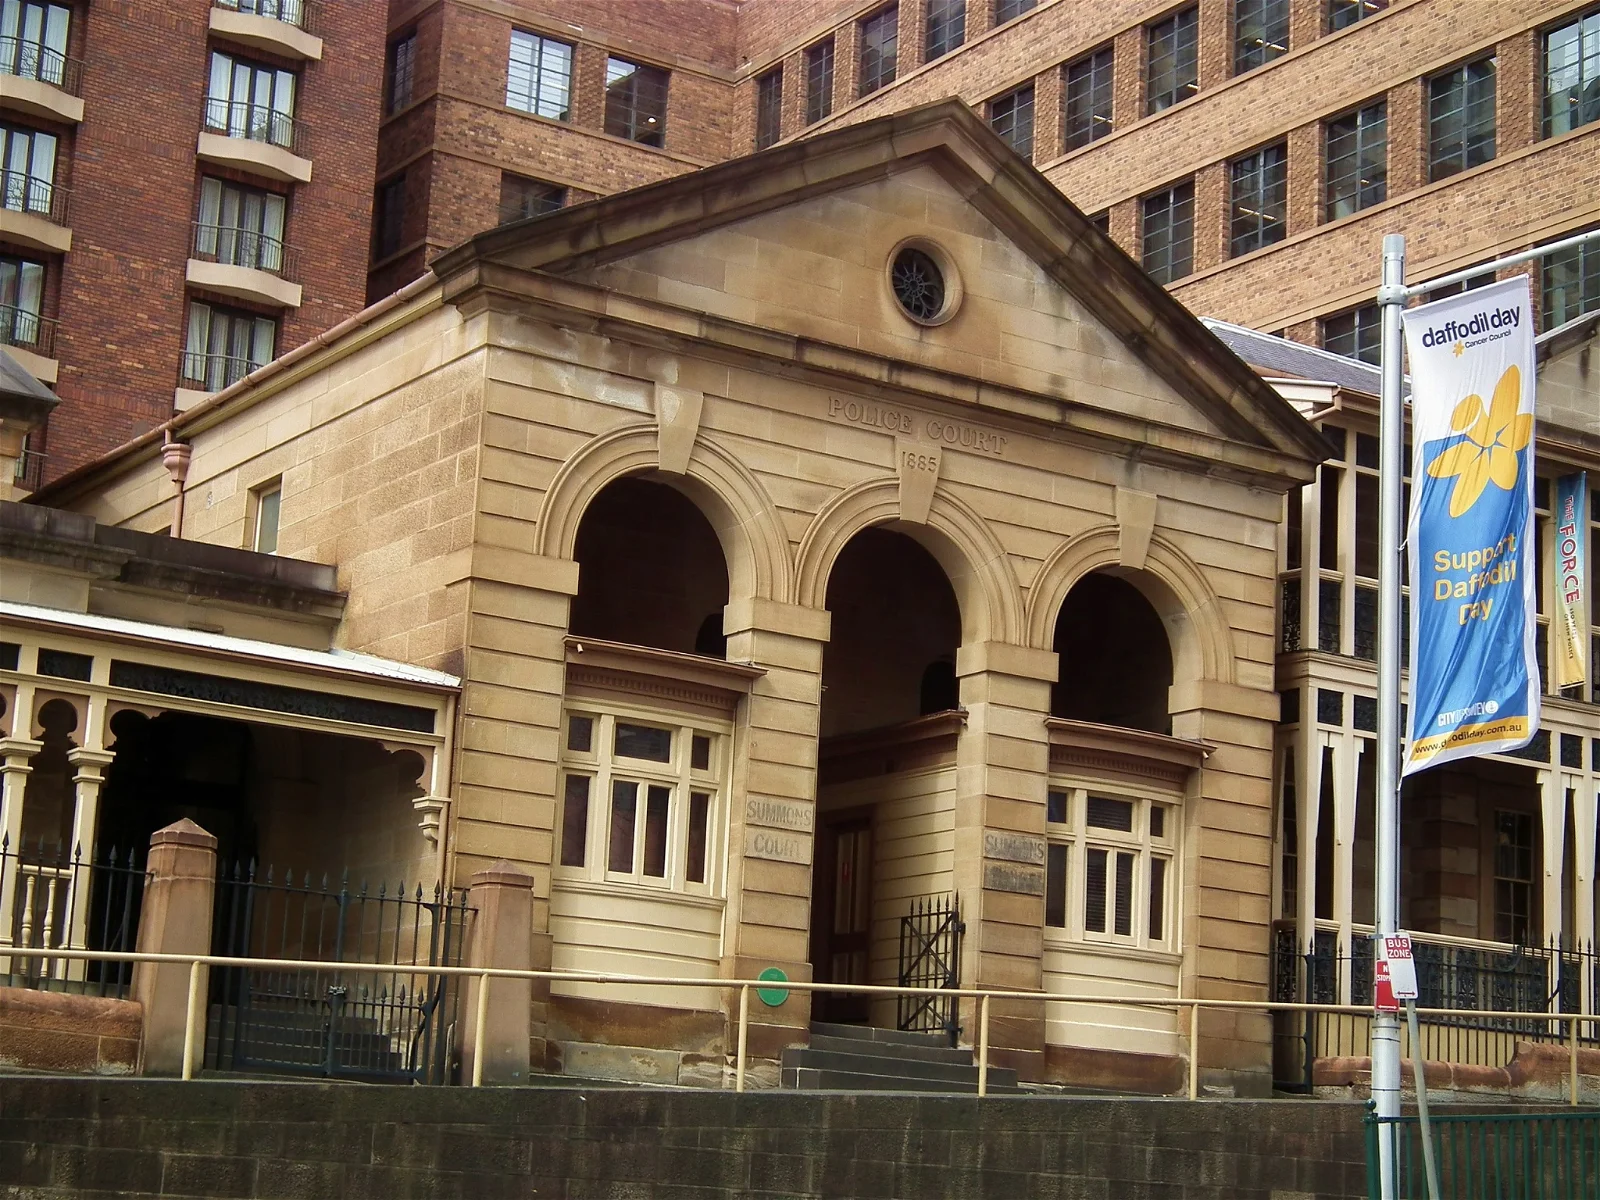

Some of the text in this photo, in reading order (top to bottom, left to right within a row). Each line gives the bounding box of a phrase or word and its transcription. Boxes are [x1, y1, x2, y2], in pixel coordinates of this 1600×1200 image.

[1422, 305, 1521, 348] daffodil day
[1464, 329, 1512, 349] Cancer Council
[828, 395, 1008, 455] POLICE COURT
[901, 450, 938, 474] 1885
[1434, 533, 1517, 573] Support
[1559, 495, 1581, 605] THE FORCE
[1434, 559, 1517, 602] Daffodil
[1459, 597, 1494, 626] Day
[1415, 724, 1522, 753] www.dodilday.com.au
[747, 800, 811, 826] SUMMONS
[1387, 939, 1408, 948] BUS
[1388, 949, 1411, 958] ZONE
